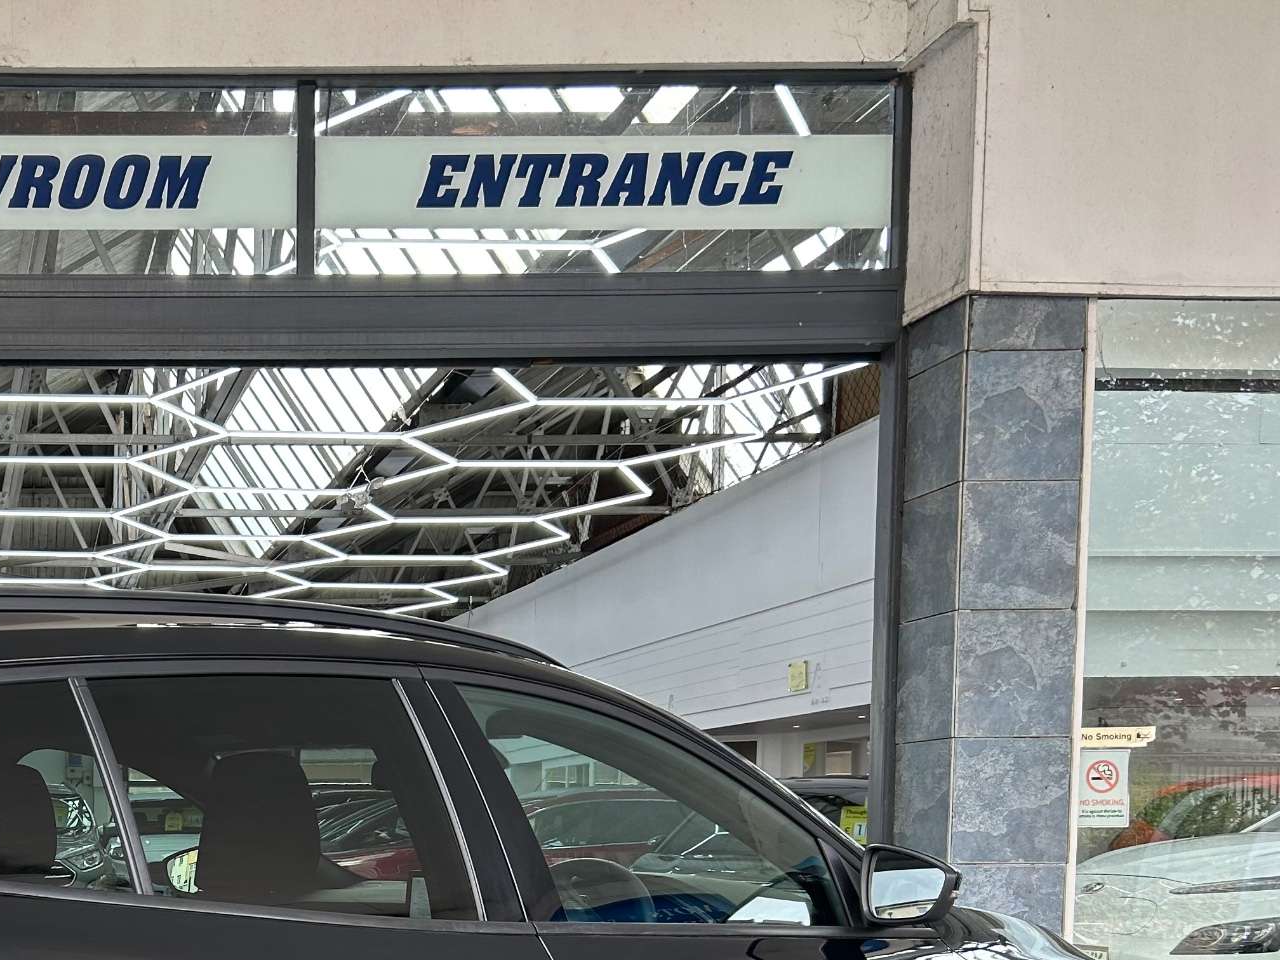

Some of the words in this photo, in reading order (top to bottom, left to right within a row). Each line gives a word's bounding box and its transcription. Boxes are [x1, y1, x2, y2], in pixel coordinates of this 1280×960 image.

[416, 151, 794, 209] ENTRANCE
[1081, 733, 1093, 741] No
[1095, 732, 1132, 741] Smoking
